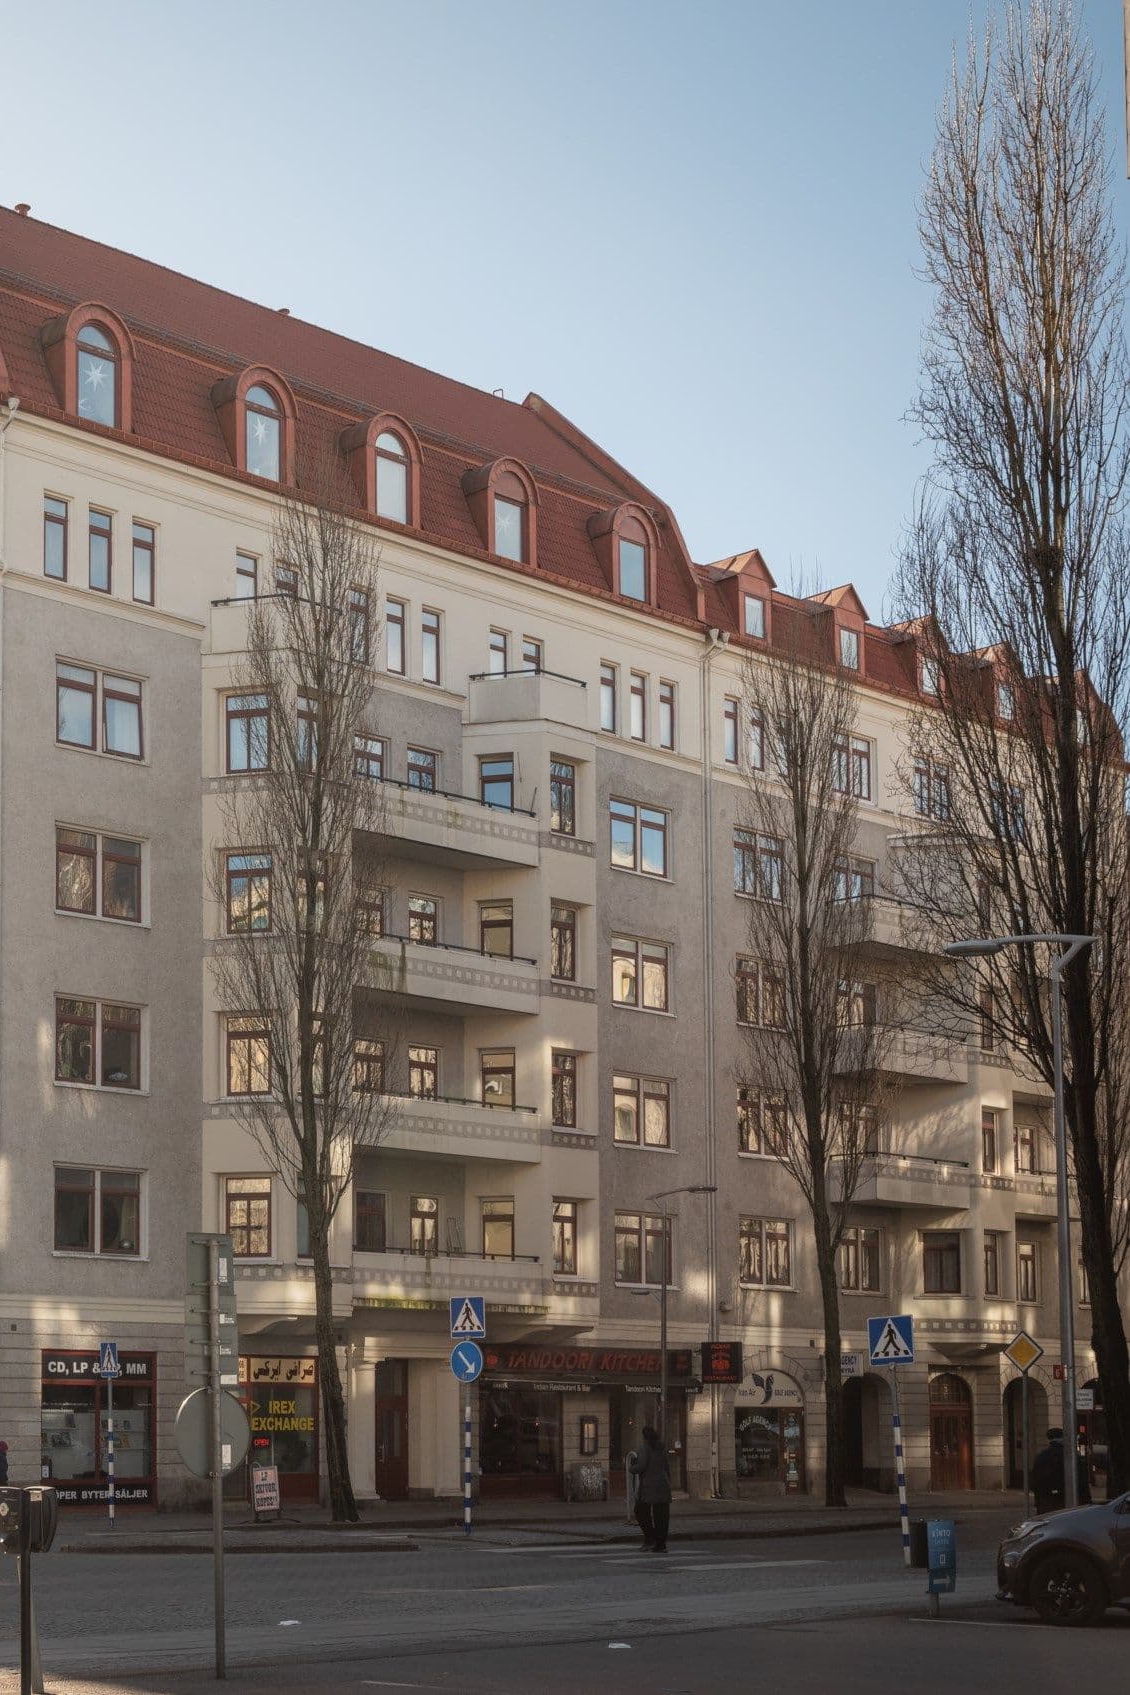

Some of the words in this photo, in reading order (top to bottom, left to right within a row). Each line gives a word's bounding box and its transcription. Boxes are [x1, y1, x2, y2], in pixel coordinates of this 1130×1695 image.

[508, 1351, 593, 1369] TANDOORI
[48, 1361, 69, 1375] CD,
[73, 1362, 88, 1373] LP
[92, 1362, 100, 1373] &
[126, 1363, 147, 1375] MM
[549, 1384, 576, 1392] Restaurant
[625, 1384, 645, 1392] Tandoori
[269, 1400, 295, 1414] IREX
[251, 1417, 315, 1431] EXCHANGE
[114, 1489, 148, 1499] SÄLJER
